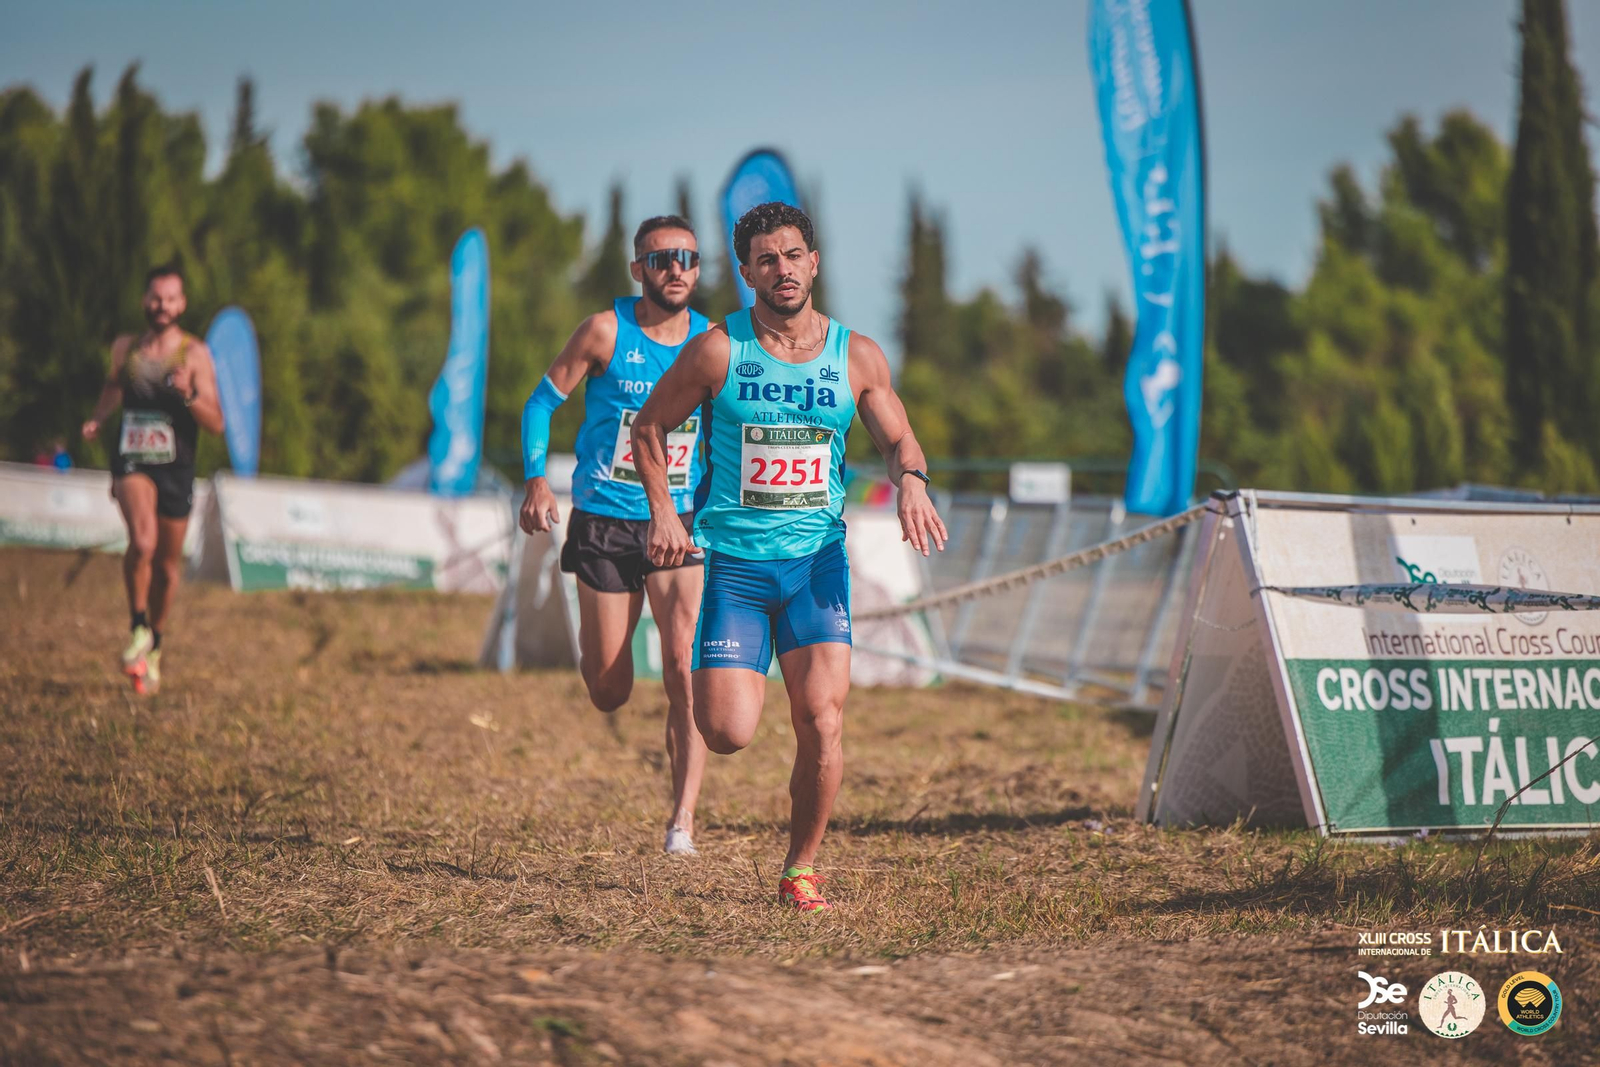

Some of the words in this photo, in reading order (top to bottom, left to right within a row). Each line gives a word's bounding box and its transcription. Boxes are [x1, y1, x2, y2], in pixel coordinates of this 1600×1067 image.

[738, 364, 763, 376] TROPS
[737, 378, 837, 412] nerja
[752, 411, 823, 426] ATLETISMO
[770, 428, 810, 440] ITÁLICA
[750, 457, 824, 486] 2251
[704, 638, 740, 648] nerja
[1362, 626, 1493, 656] International
[1497, 628, 1554, 655] Cross
[1317, 668, 1433, 711] CROSS
[1430, 718, 1600, 806] ITÁLIC
